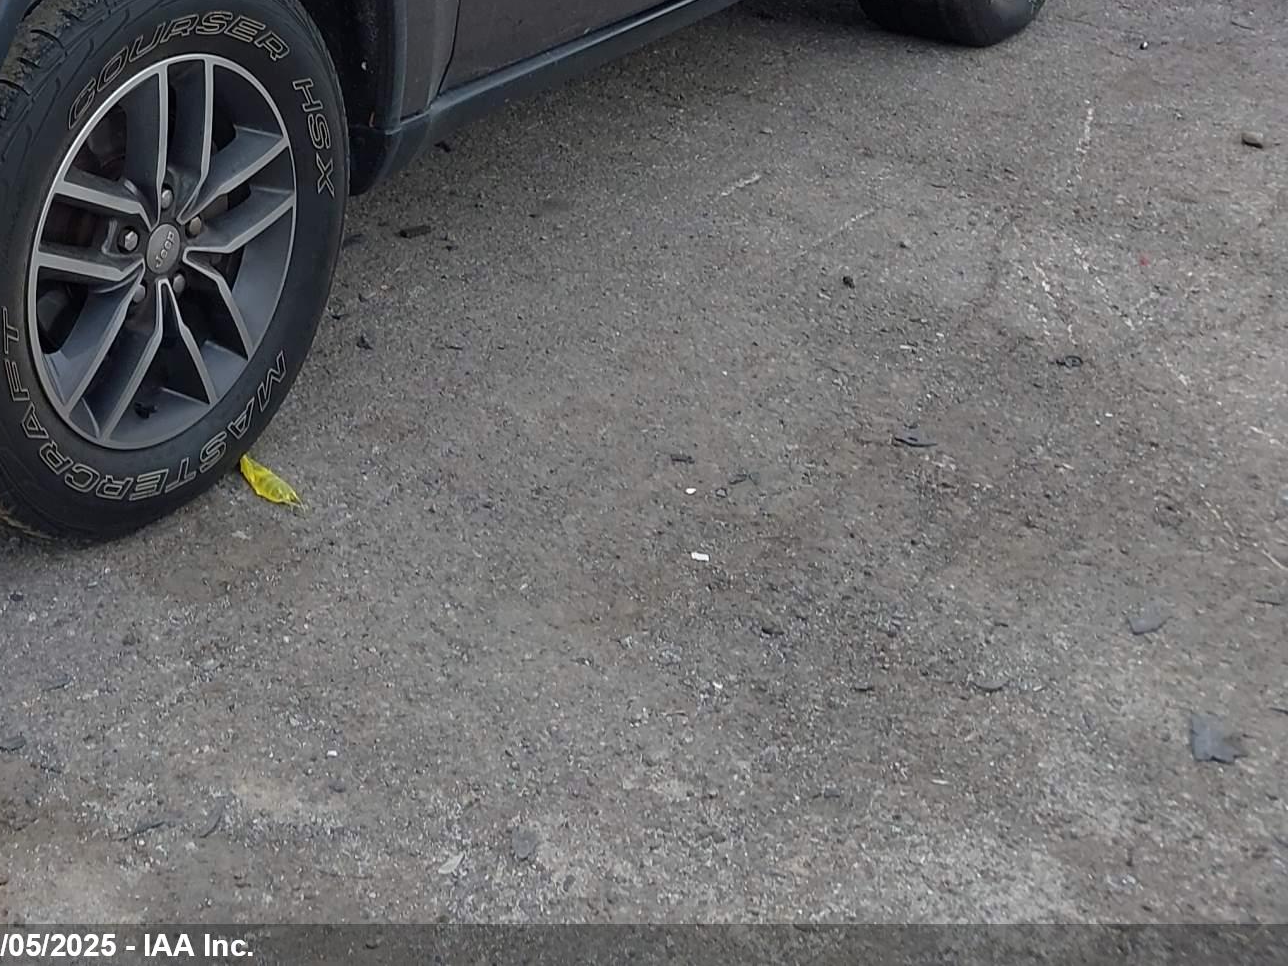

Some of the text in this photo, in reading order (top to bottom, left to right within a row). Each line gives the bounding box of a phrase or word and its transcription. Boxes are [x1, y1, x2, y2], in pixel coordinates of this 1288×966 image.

[68, 10, 335, 198] COURSER HSX
[155, 230, 175, 268] Jeep
[1, 306, 287, 502] MASTERCRAFT
